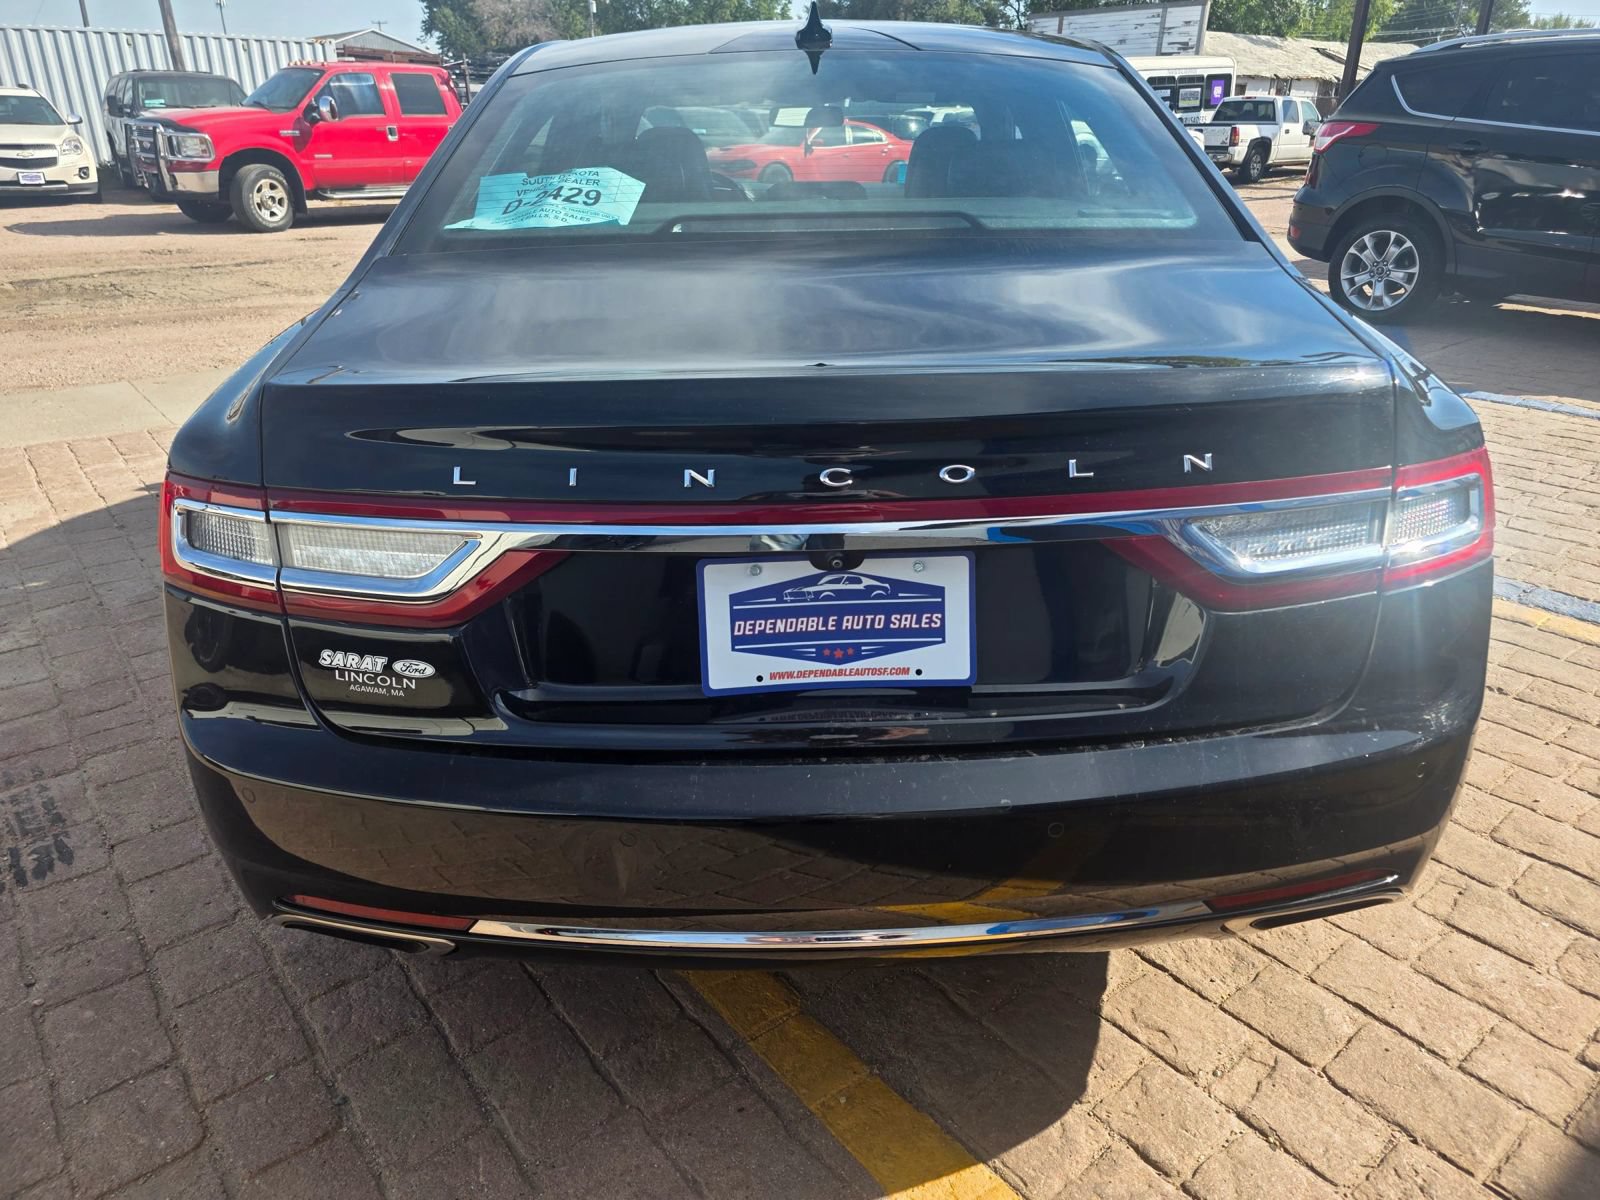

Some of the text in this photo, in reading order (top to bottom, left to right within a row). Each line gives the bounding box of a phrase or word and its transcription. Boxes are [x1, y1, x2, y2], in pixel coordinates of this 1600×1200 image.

[502, 185, 602, 215] D-2429
[539, 207, 562, 215] AUTO
[563, 212, 591, 222] SALES
[453, 452, 1213, 487] LINCOLN
[733, 613, 942, 636] DEPENDABLE AUTO SALES
[319, 649, 388, 673] SARAT
[335, 669, 416, 689] LINCOLN
[769, 667, 911, 681] WWW.DEPENDABLEAUTOSF.COM
[349, 684, 405, 697] AGAWAM, MA
